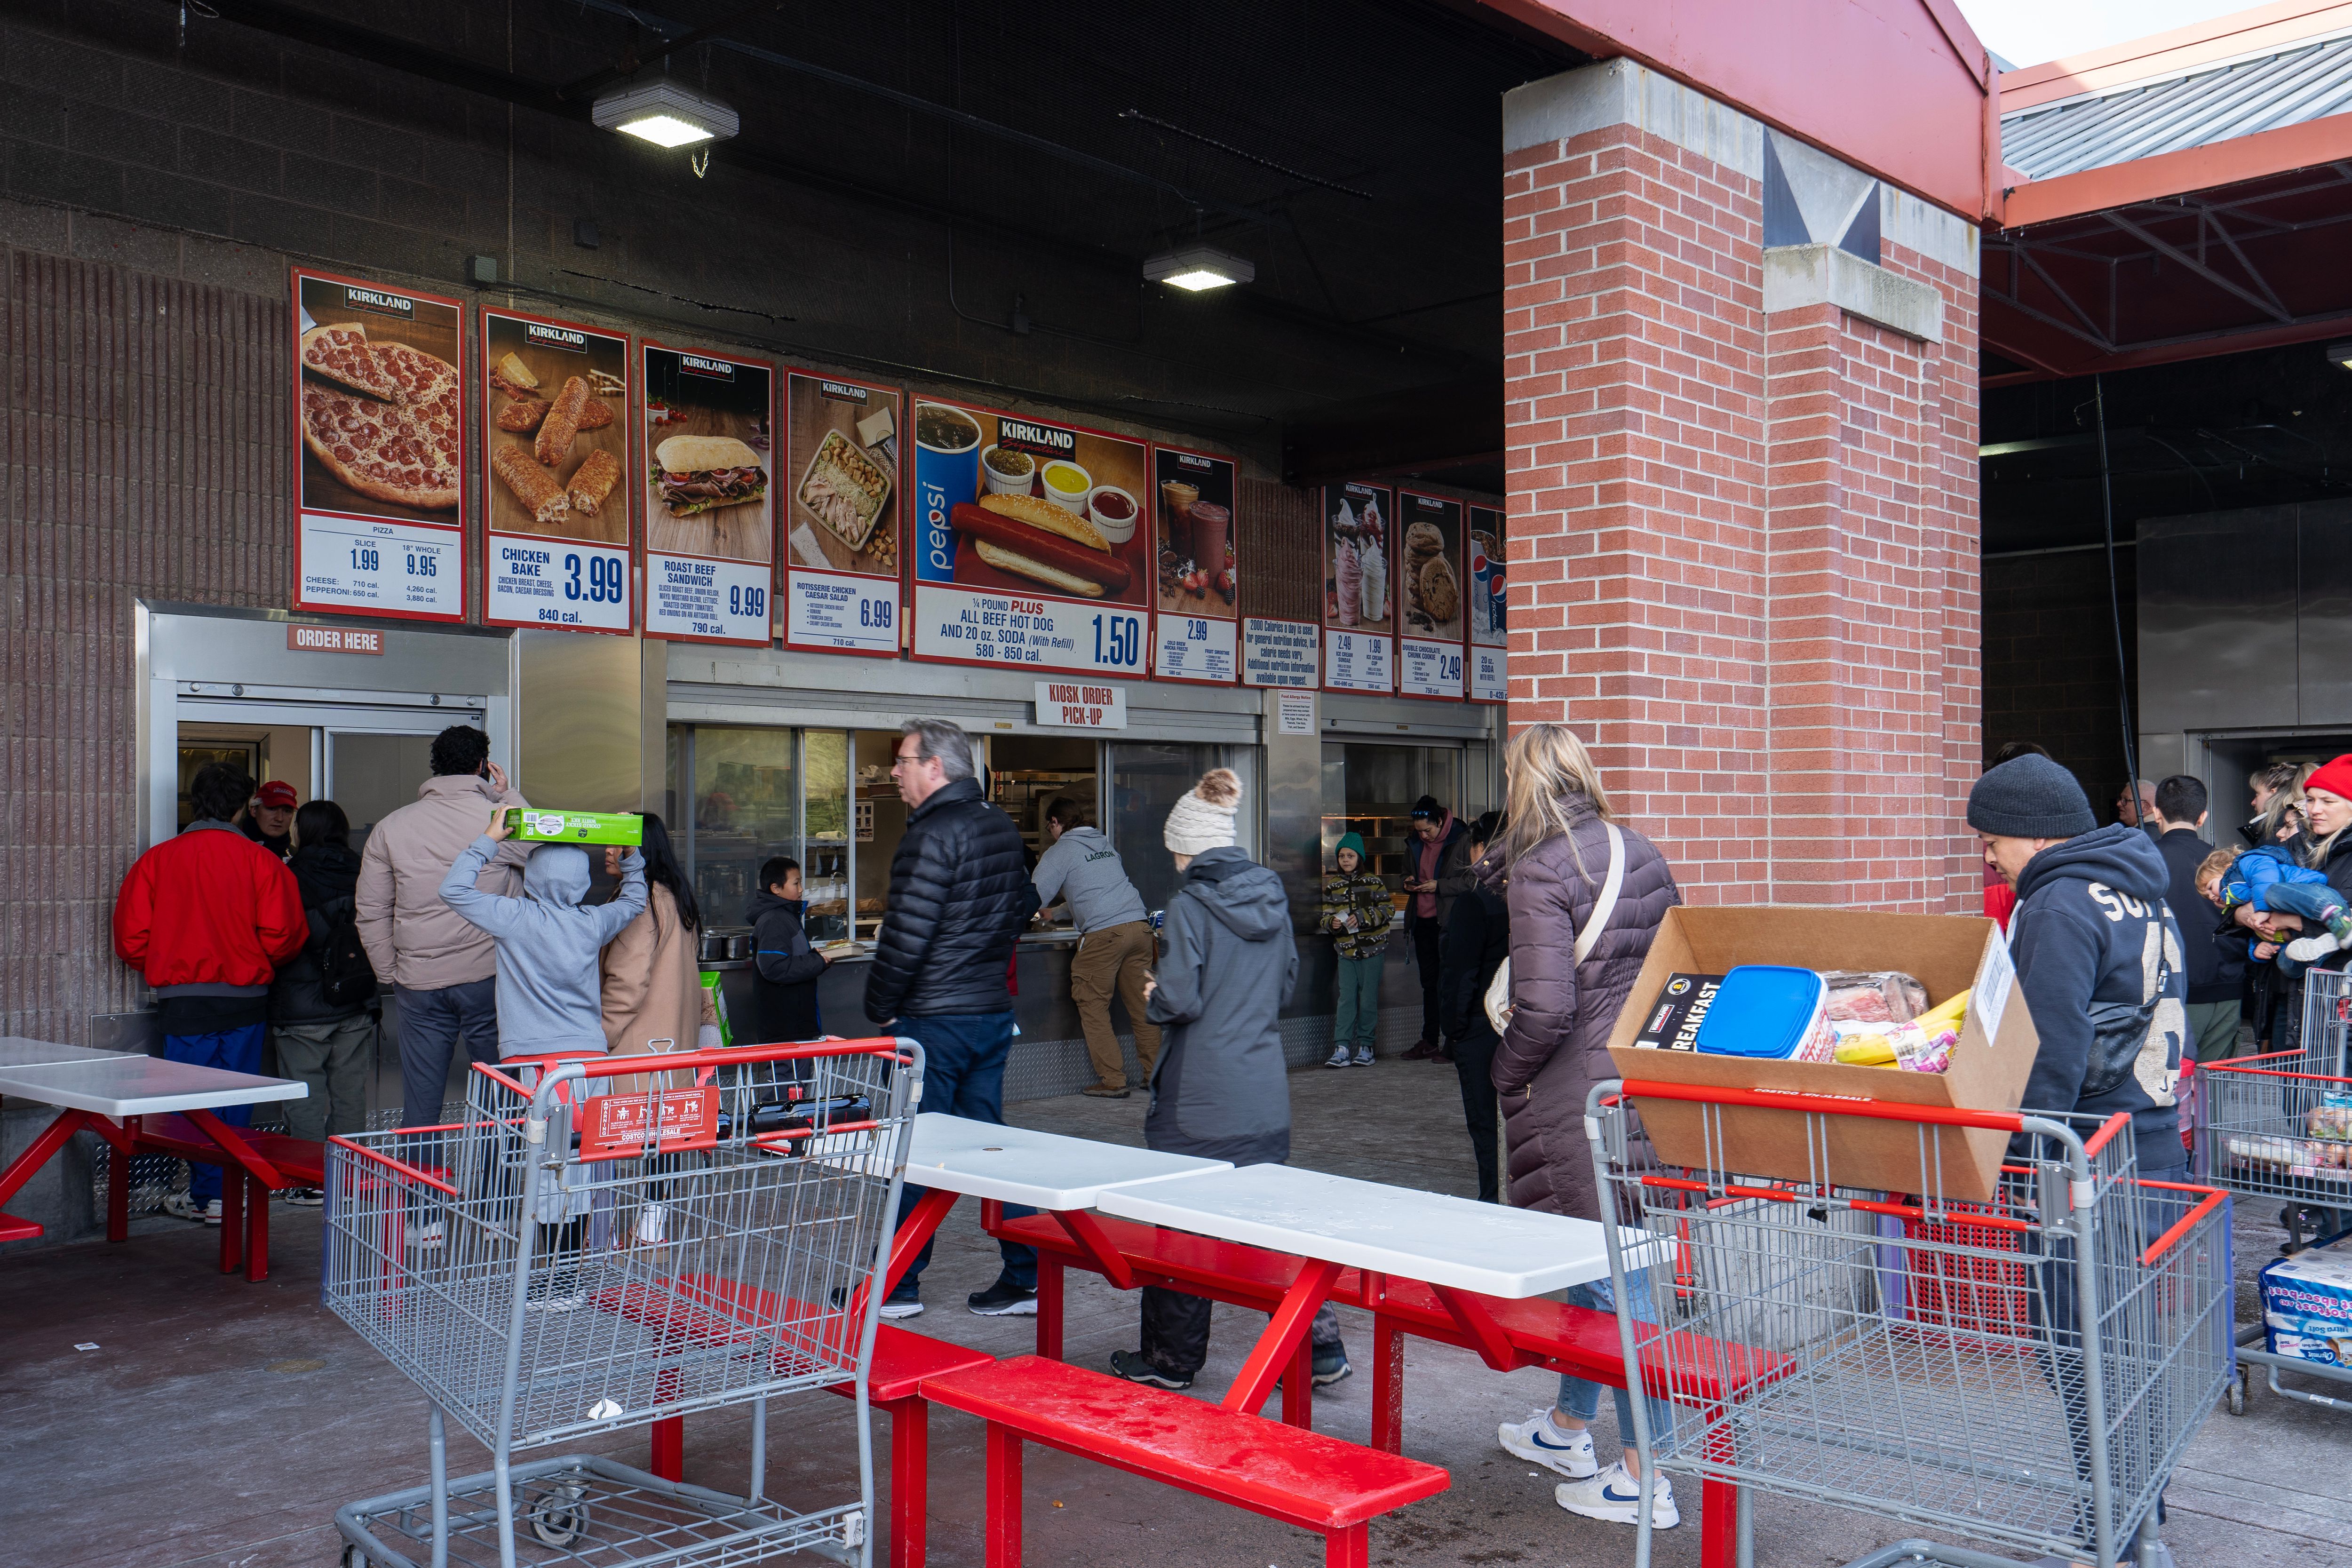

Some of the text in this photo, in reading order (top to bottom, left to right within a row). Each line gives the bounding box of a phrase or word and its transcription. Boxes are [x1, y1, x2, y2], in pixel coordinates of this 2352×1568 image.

[349, 288, 411, 310] KIRKLAND
[347, 301, 411, 317] Signature
[529, 325, 584, 344] KIRKLAND
[683, 356, 731, 374] KIRKLAND
[823, 382, 866, 398] KIRKLAND
[1002, 422, 1073, 448] KIRKLAND
[1002, 438, 1073, 457] Signature
[1180, 455, 1210, 468] KIRKLAND
[1346, 485, 1372, 495] KIRKLAND
[1418, 498, 1442, 508] KIRKLAND
[922, 481, 952, 569] pepsi
[351, 549, 379, 571] 1.99
[502, 548, 549, 564] CHICKEN
[407, 554, 437, 577] 9.95
[512, 563, 540, 576] BAKE
[665, 561, 715, 575] ROAST BEEF
[306, 576, 339, 585] CHEESE:
[498, 576, 553, 589] CHICKEN BREAST, CHEESE,
[565, 554, 622, 604] 3.99
[668, 573, 712, 587] SANDWICH
[306, 586, 352, 596] PEPPERONI:
[498, 585, 554, 597] BACON, CAESAR DRESSING
[797, 582, 856, 595] ROTISSERIE CHICKEN
[730, 585, 764, 617] 9.99
[982, 599, 1008, 611] POUND
[1011, 600, 1044, 615] PLUS
[539, 609, 582, 623] 840 cal.
[861, 599, 891, 628] 6.99
[961, 610, 1053, 631] ALL BEEF HOT DOG
[692, 622, 725, 634] 790 cal.
[1188, 620, 1207, 641] 2.99
[1250, 620, 1263, 631] 2000
[1264, 621, 1283, 633] Calories
[1298, 624, 1301, 634] is
[1303, 625, 1312, 635] used
[297, 629, 377, 650] ORDER HERE
[941, 623, 1074, 650] AND 20 oz. SODA (With Refill)
[1093, 614, 1139, 666] 1.50
[1255, 635, 1271, 645] general
[1273, 635, 1292, 646] nutrition
[1294, 637, 1308, 649] advice,
[1338, 635, 1351, 650] 2.49
[976, 644, 1041, 662] 580 850 cal.
[1261, 647, 1303, 661] calorie needs vary.
[1369, 639, 1381, 653] 1.99
[1248, 659, 1315, 673] Additional nutrition information
[1441, 655, 1460, 680] 2.49
[1256, 673, 1307, 686] available upon request.
[1049, 685, 1113, 705] KIOSK ORDER
[1062, 706, 1102, 725] PICK-UP
[527, 827, 534, 836] 12
[1085, 851, 1115, 862] LAGRON
[1651, 1006, 1669, 1031] KIRKLAND
[1671, 982, 1721, 1050] REAKFAST
[1812, 1015, 1830, 1057] HOUR
[2268, 1286, 2338, 1308] absorbent
[2296, 1301, 2346, 1318] softest
[2308, 1351, 2333, 1361] Charmin
